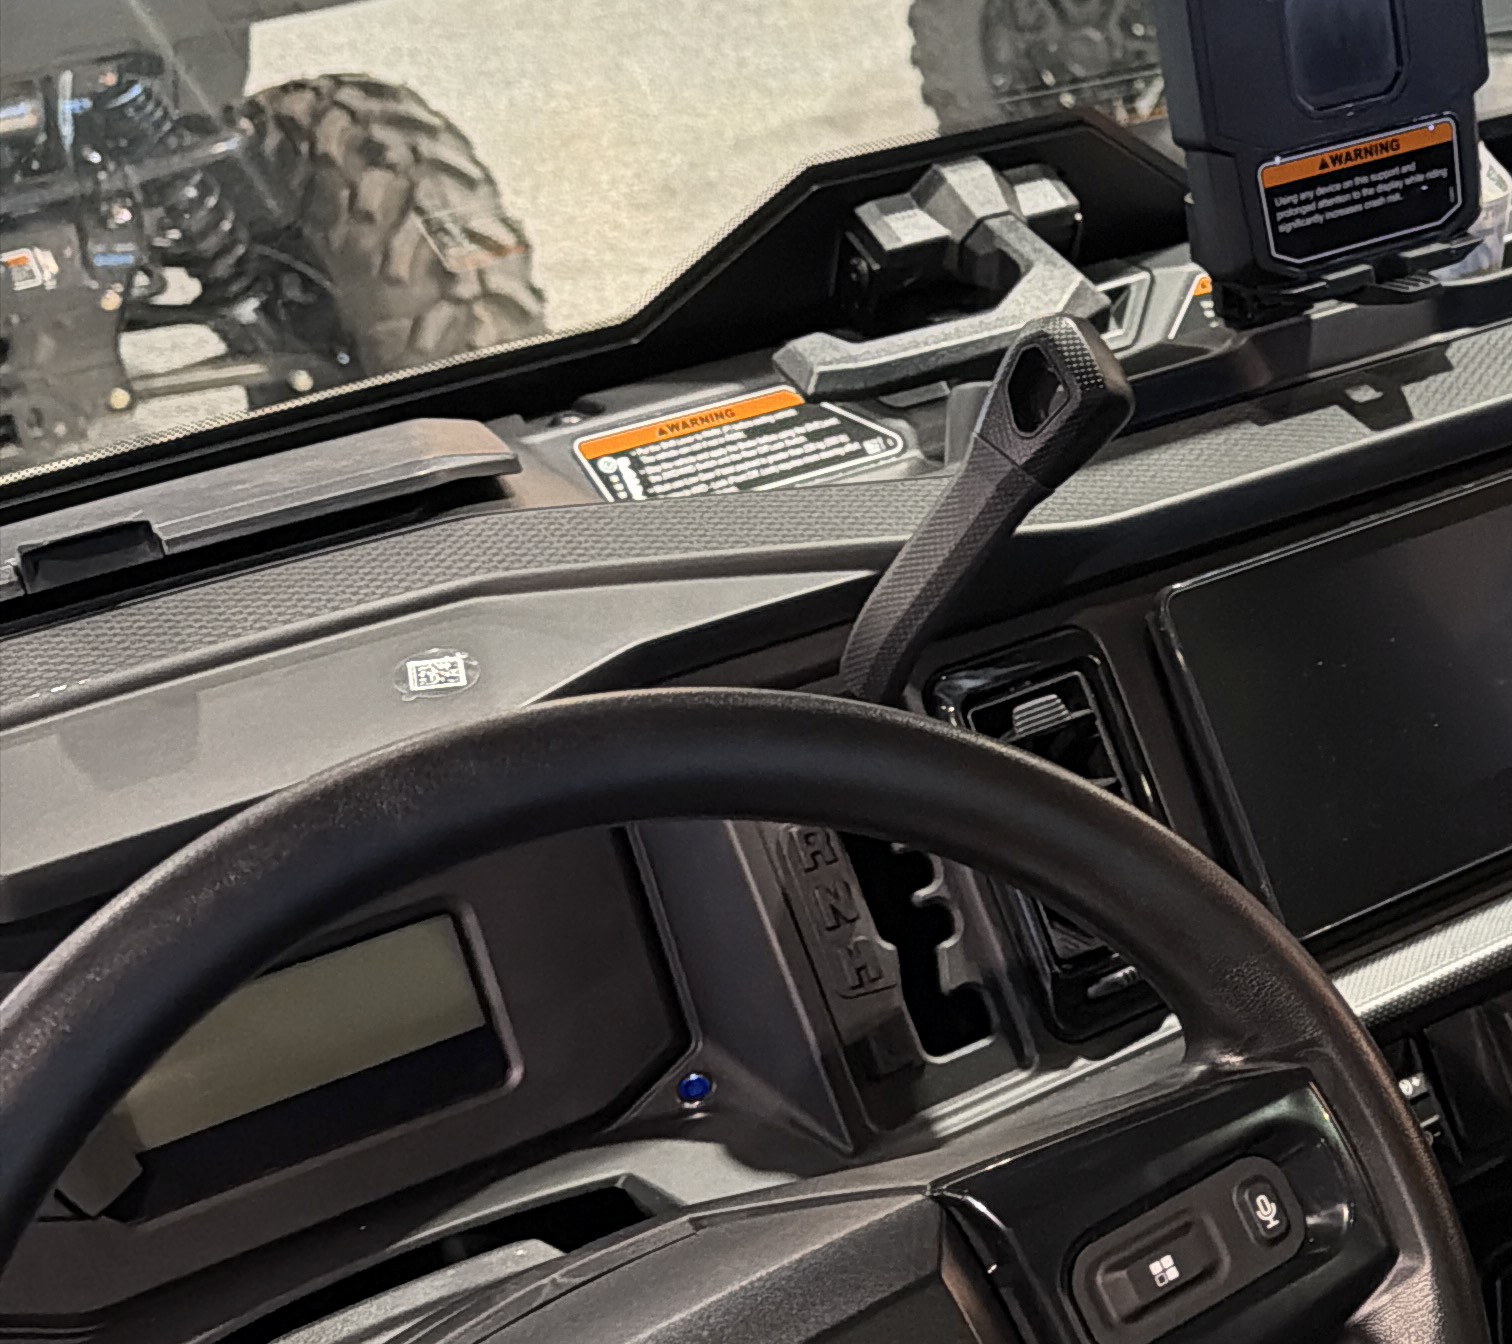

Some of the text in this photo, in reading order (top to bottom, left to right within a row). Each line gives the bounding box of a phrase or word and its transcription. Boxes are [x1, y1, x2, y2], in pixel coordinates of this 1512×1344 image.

[1329, 139, 1400, 169] WARNING
[1274, 194, 1298, 206] Using
[1300, 190, 1314, 201] any
[1316, 183, 1342, 196] device
[1342, 180, 1353, 189] on
[1370, 166, 1400, 181] support
[1401, 161, 1416, 173] and
[1276, 167, 1448, 222] prolonged attention to the display while riding
[1278, 214, 1324, 233] significantly
[1325, 204, 1363, 220] increases
[1364, 196, 1386, 209] crash
[668, 408, 735, 433] WARNING
